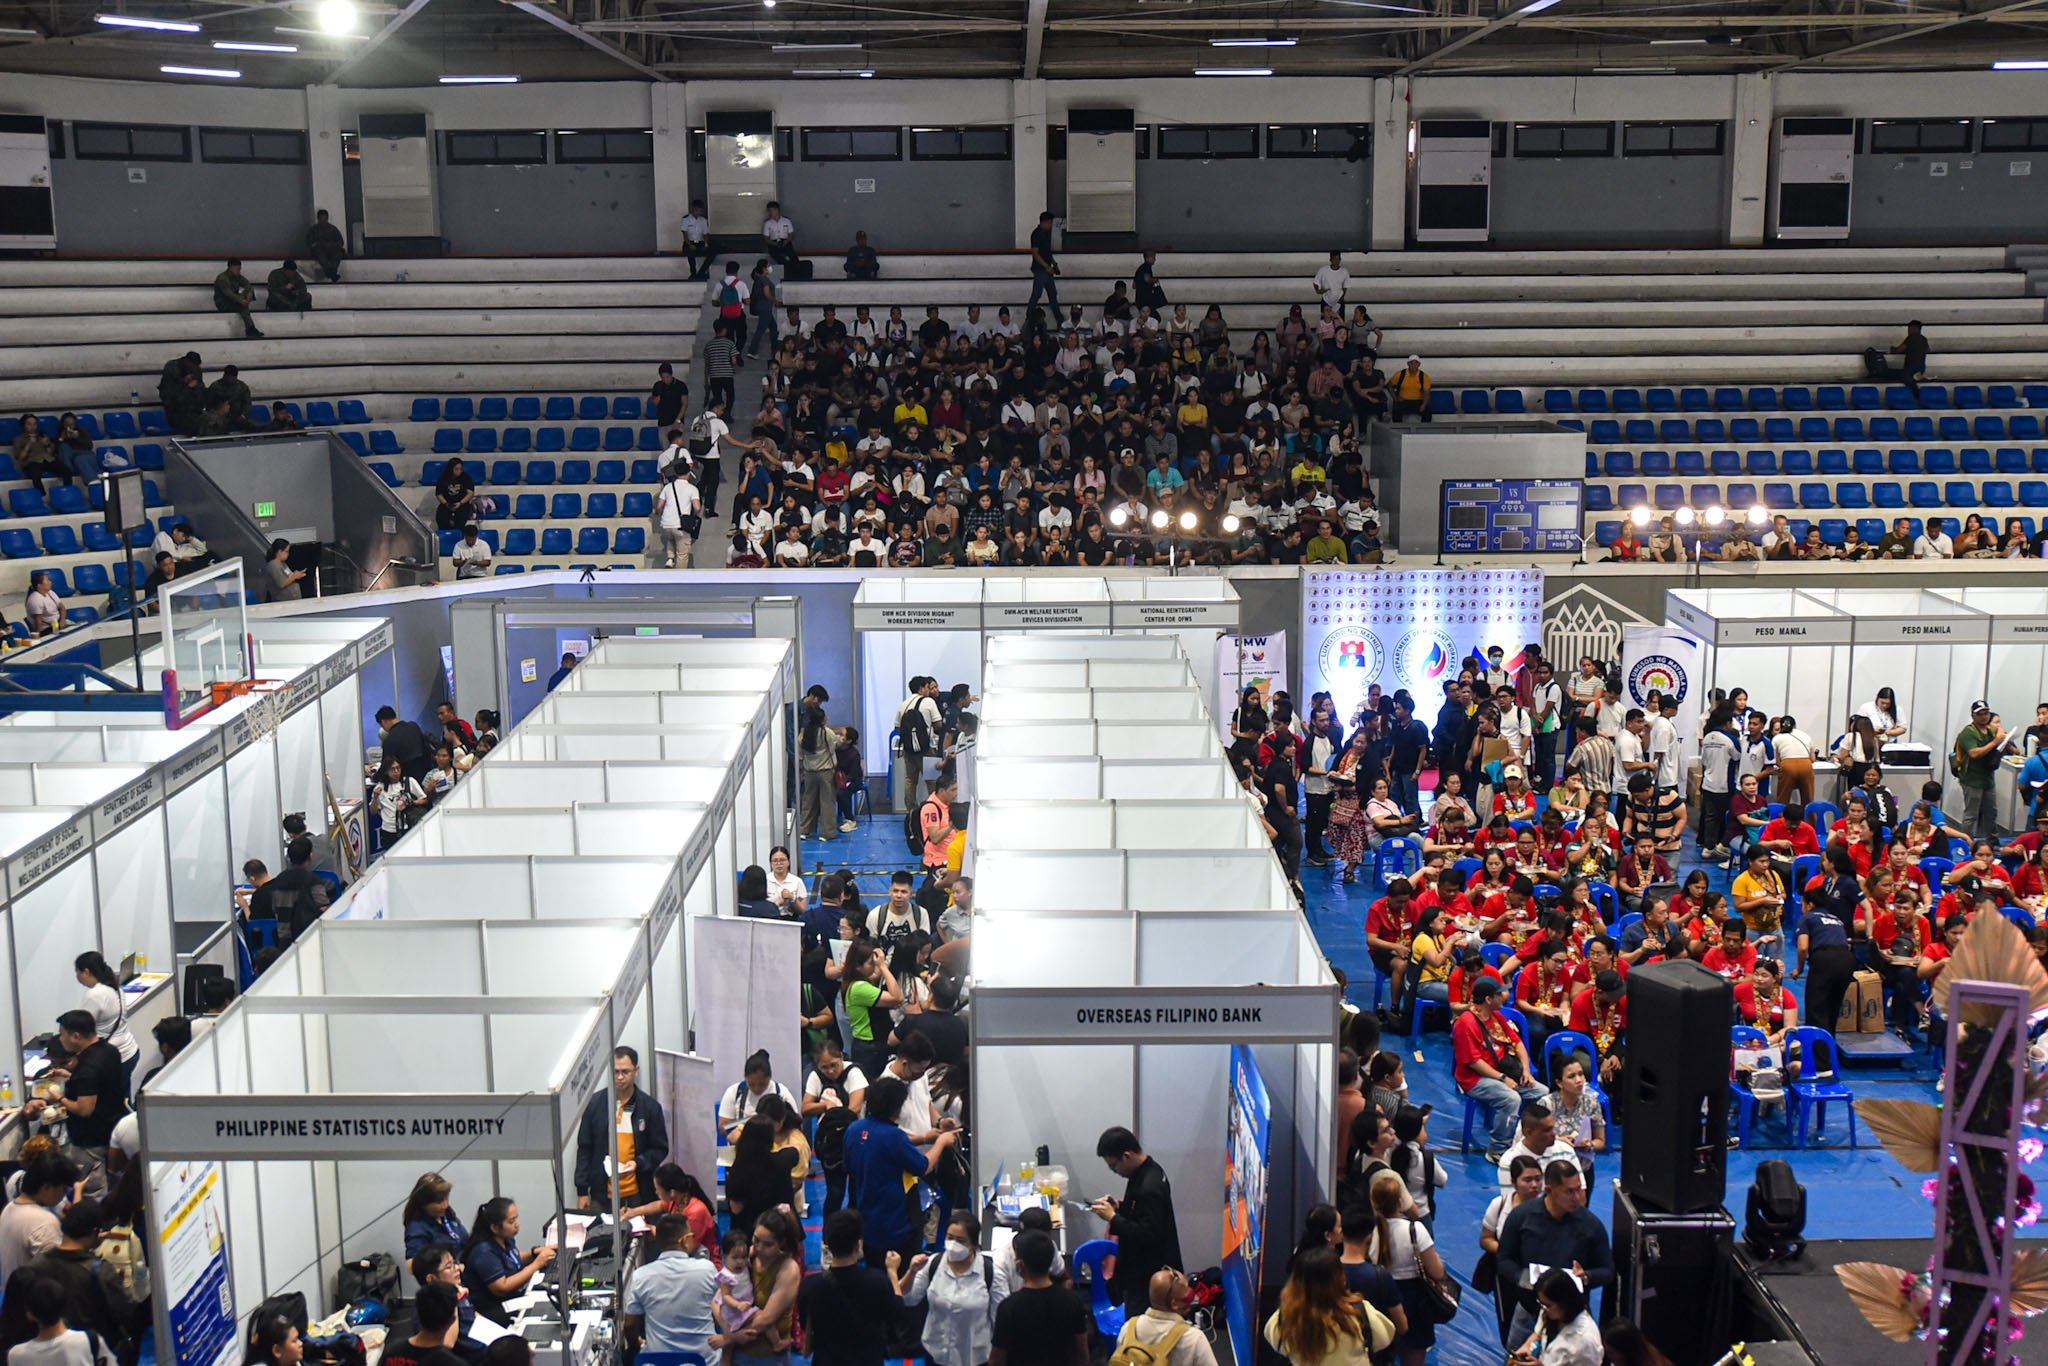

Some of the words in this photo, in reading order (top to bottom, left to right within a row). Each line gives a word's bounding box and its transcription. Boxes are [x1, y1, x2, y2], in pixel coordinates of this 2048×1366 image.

[1509, 488, 1518, 497] VS
[1360, 630, 1382, 656] MAYNILA
[1755, 627, 1775, 636] PESO
[1779, 627, 1807, 635] MANILA
[1902, 626, 1922, 634] PESO
[1923, 626, 1952, 634] MANILA
[1395, 634, 1412, 674] DEPARTMENT
[1630, 657, 1655, 681] LUNGSOD
[1667, 660, 1686, 687] MAYNILA
[103, 791, 130, 816] DEPARTMENT
[130, 789, 136, 800] OF
[136, 777, 152, 796] SCIENCE
[114, 811, 122, 825] AND
[122, 795, 148, 819] TECHNOLOGY
[23, 838, 54, 867] DEPARTMENT
[54, 834, 61, 846] OF
[61, 823, 78, 842] SOCIAL
[18, 862, 41, 887] WELFARE
[41, 857, 51, 872] AND
[51, 835, 84, 866] DEVELOPMENT
[1076, 1008, 1151, 1024] OVERSEAS
[1156, 1008, 1218, 1023] FILIPINO
[1222, 1008, 1262, 1023] BANK
[215, 1120, 308, 1137] PHILIPPINE
[313, 1119, 406, 1135] STATISTICS
[411, 1118, 505, 1135] AUTHORITY
